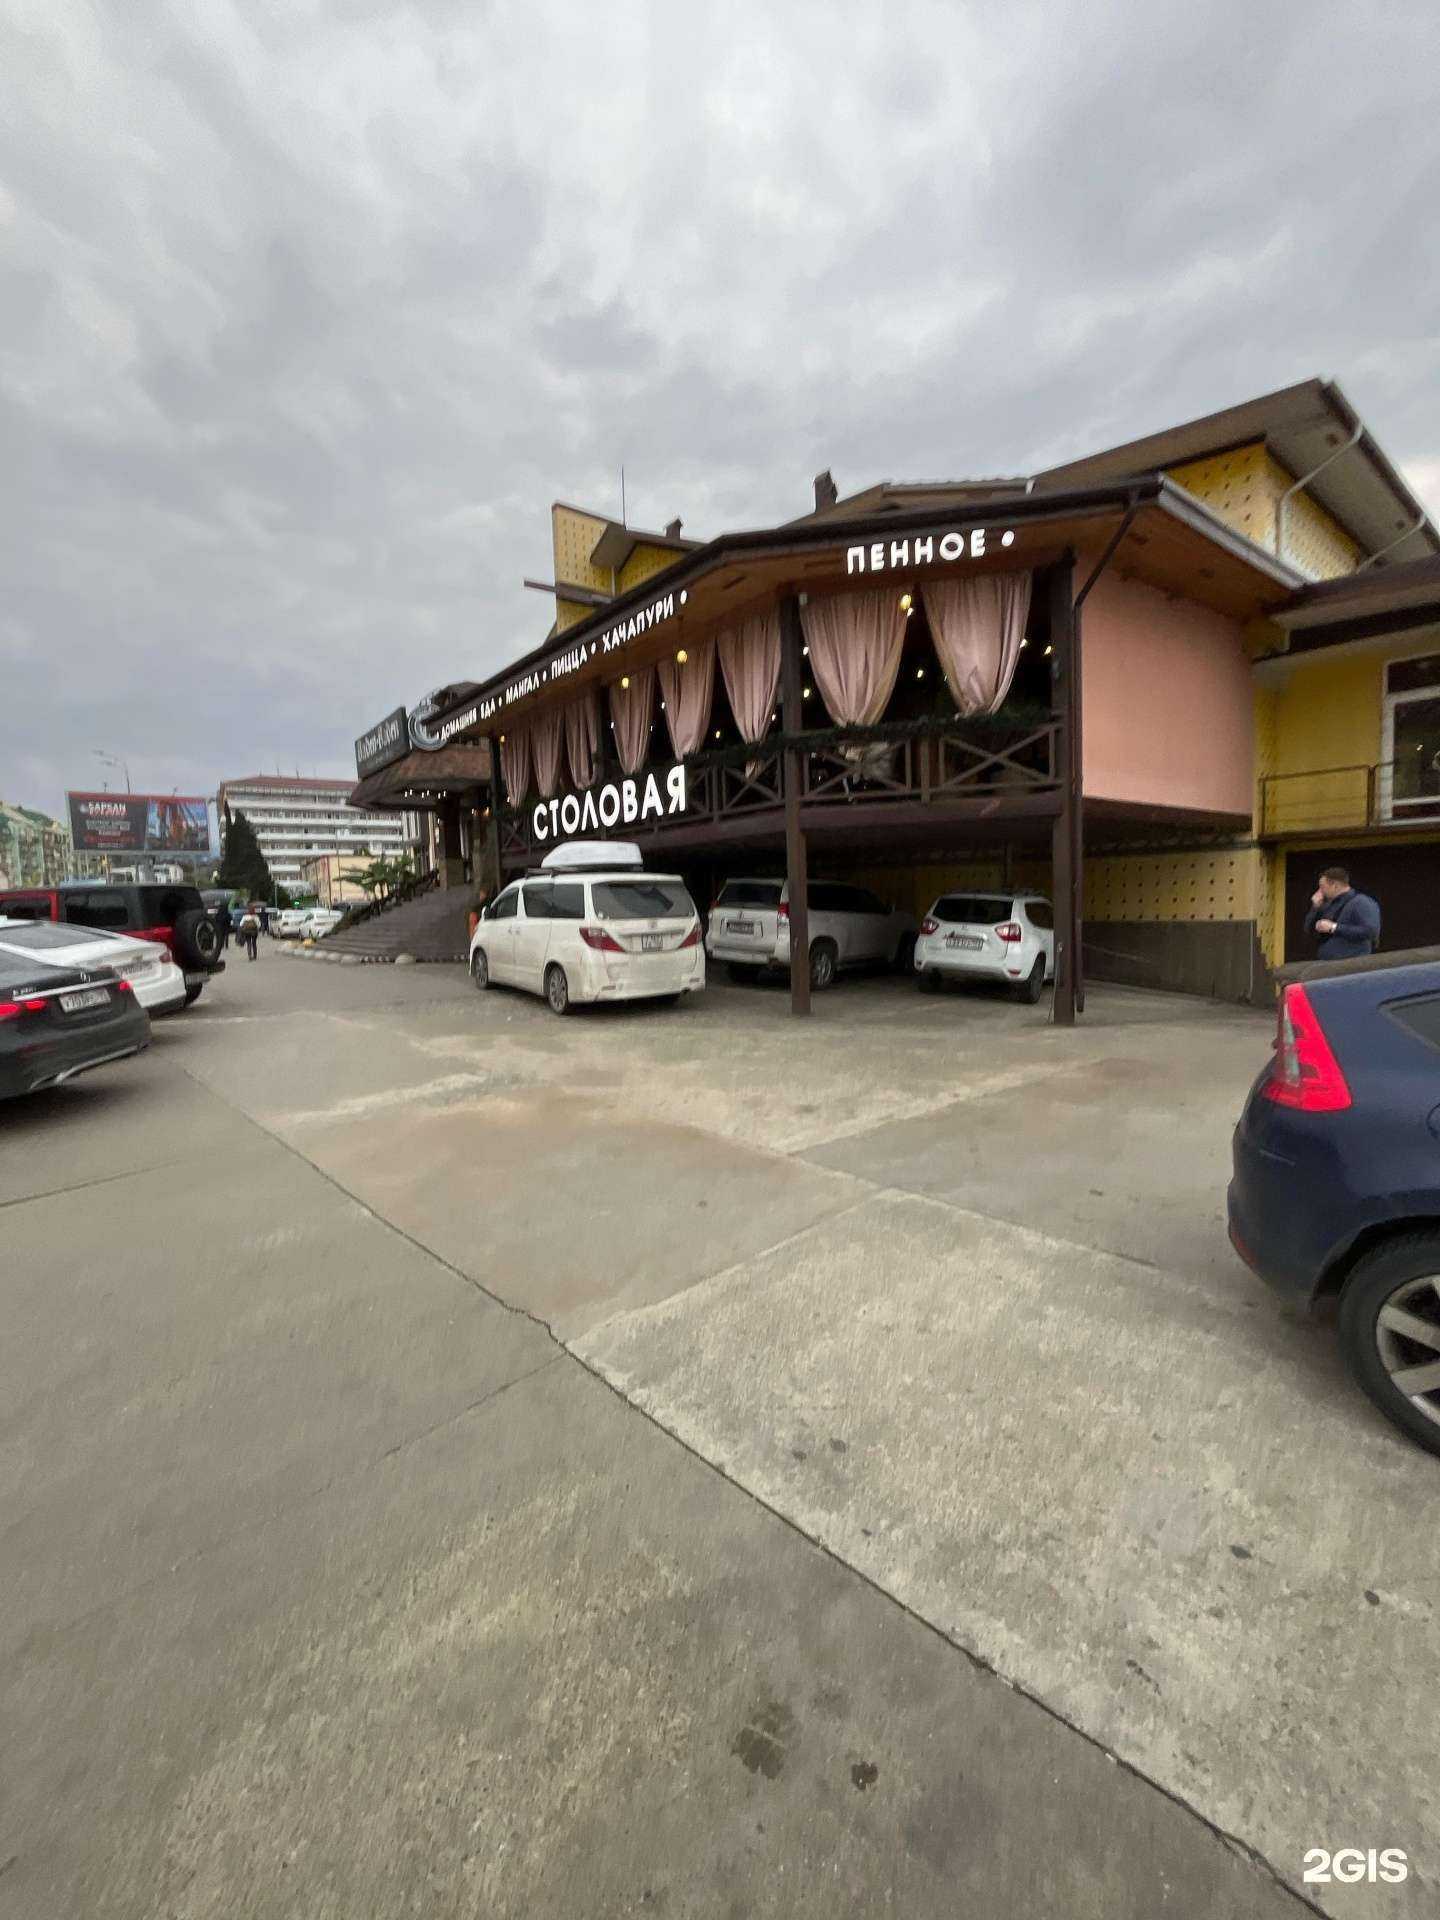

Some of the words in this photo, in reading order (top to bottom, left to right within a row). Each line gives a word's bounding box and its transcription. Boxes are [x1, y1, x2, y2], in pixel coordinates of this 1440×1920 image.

[847, 528, 986, 575] ПЕННОЕ
[480, 697, 496, 719] ЕДА
[505, 671, 540, 705] МАНГАЛ
[551, 643, 588, 680] ПИЦЦА
[602, 592, 674, 654] ХАЧАПУРИ
[533, 764, 686, 840] СТОЛОВАЯ
